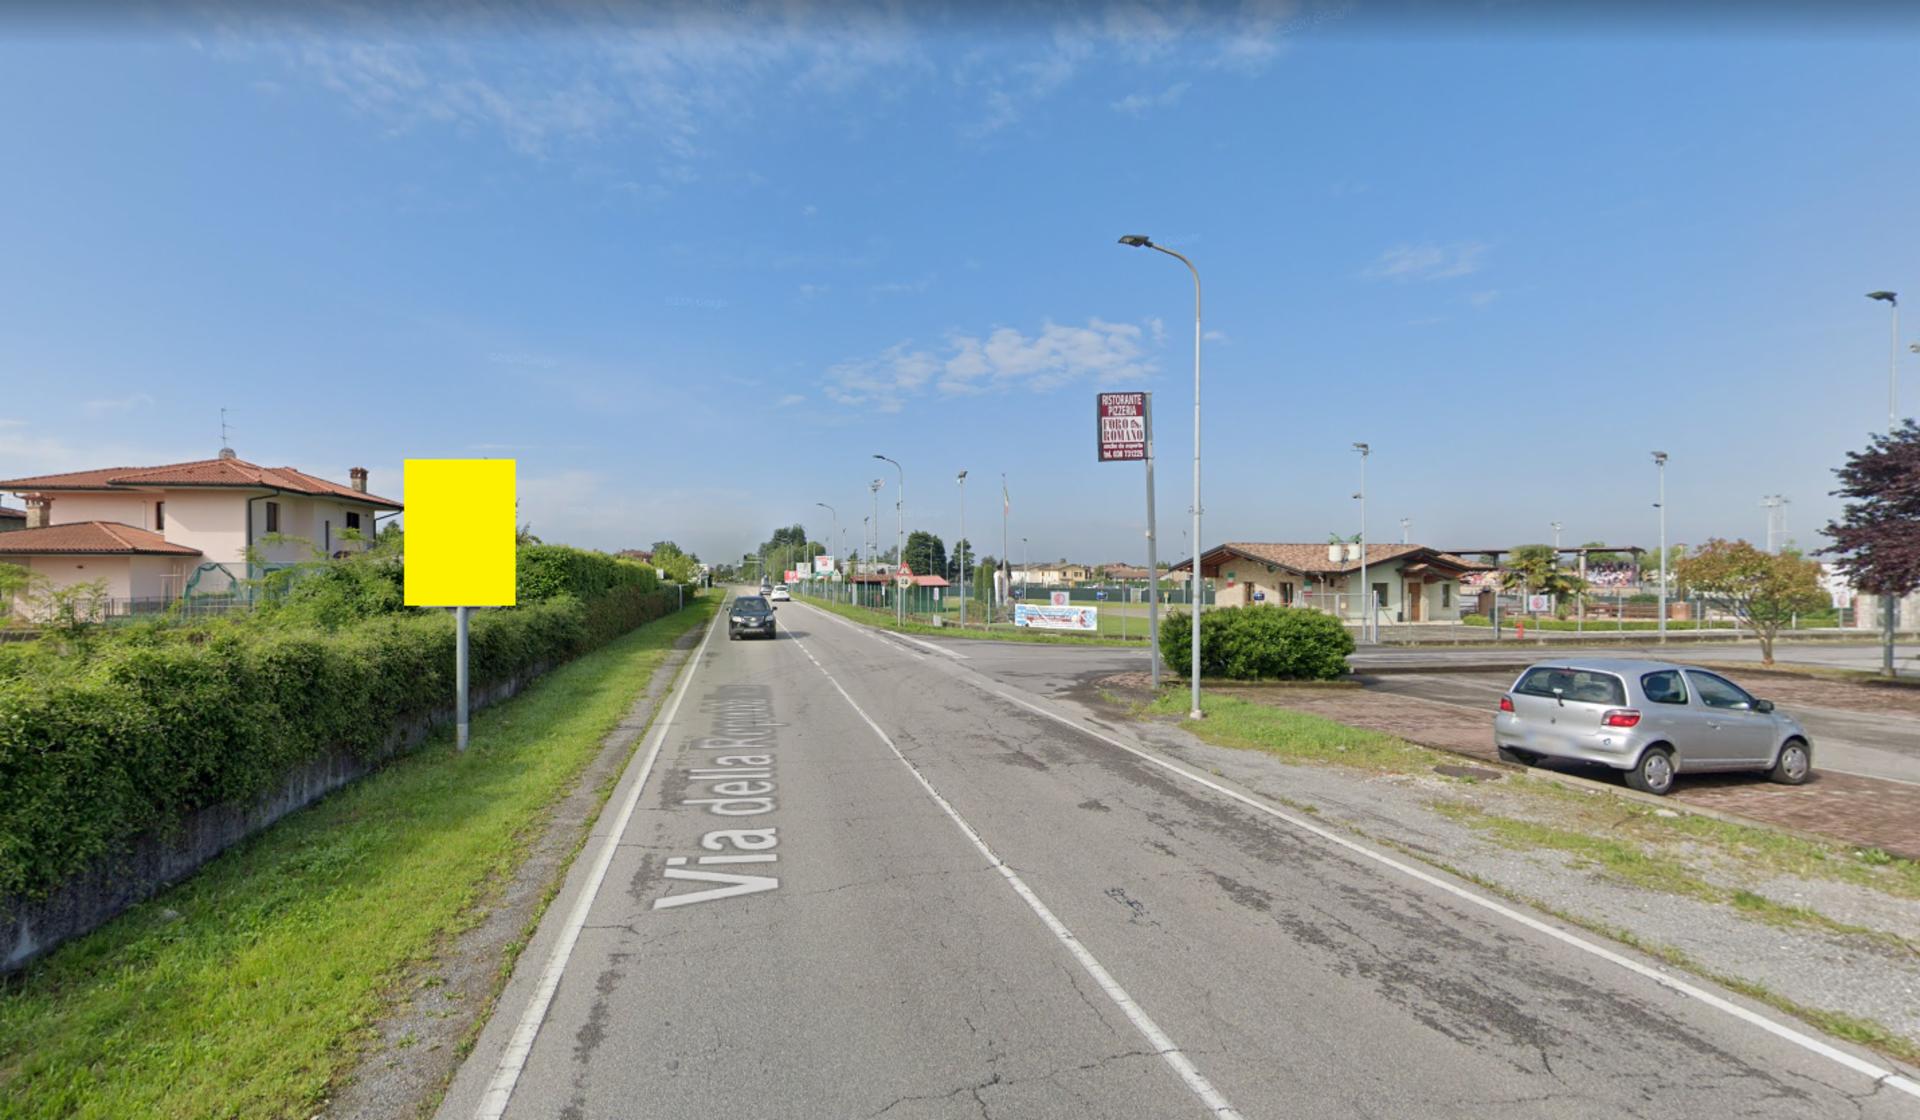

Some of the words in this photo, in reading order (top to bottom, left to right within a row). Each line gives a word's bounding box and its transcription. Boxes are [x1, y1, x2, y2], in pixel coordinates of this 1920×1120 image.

[1102, 394, 1142, 405] RISTORANTE
[1108, 405, 1137, 416] PIZZERIA
[1103, 418, 1128, 430] FORO
[1103, 430, 1143, 441] ROMANO
